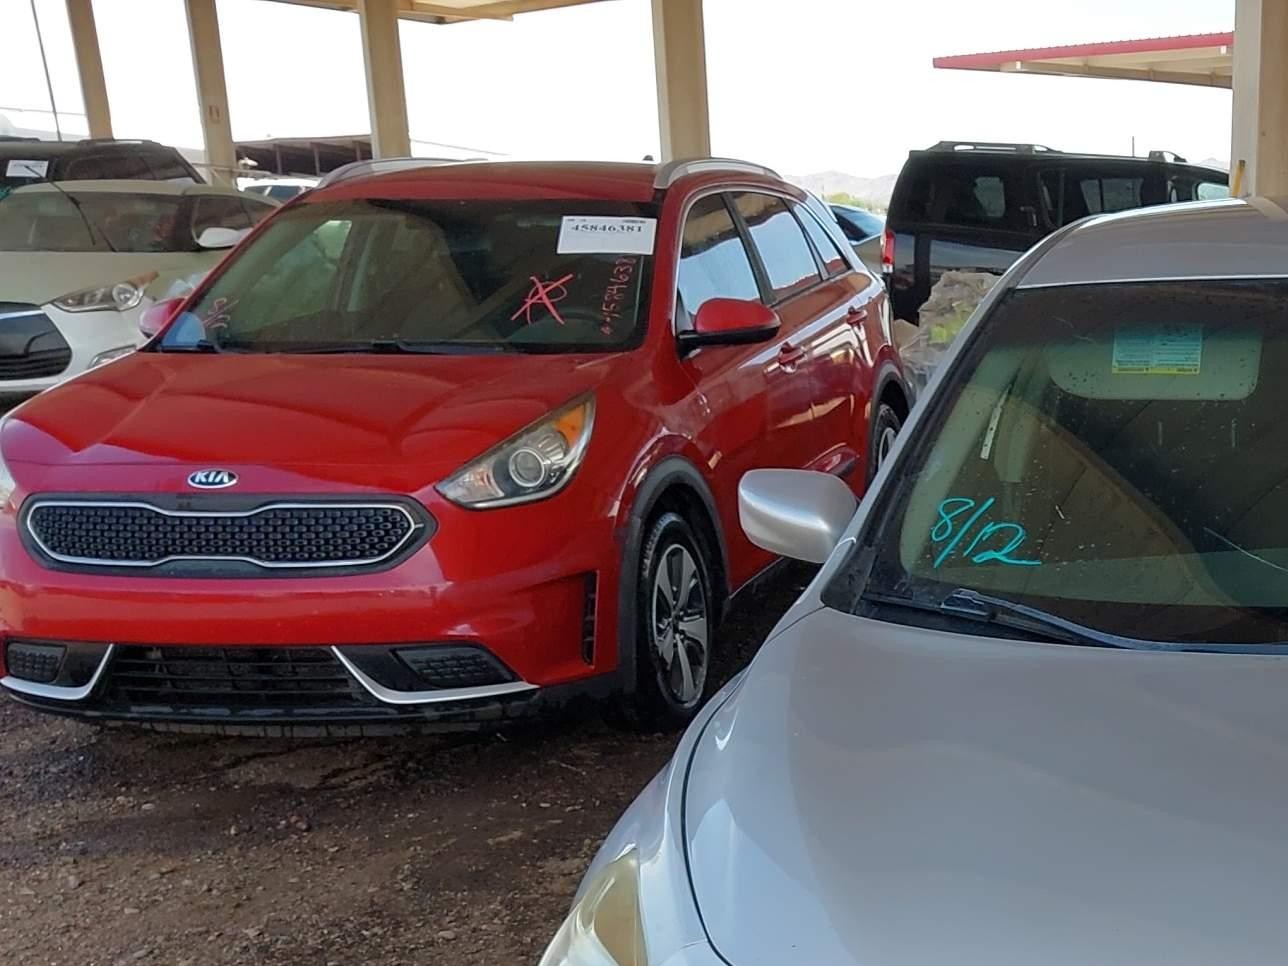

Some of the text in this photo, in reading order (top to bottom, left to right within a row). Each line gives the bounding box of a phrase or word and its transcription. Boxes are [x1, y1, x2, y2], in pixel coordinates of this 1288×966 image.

[571, 224, 642, 233] 45846381
[194, 471, 229, 483] KIA
[931, 498, 1042, 568] 8/12
